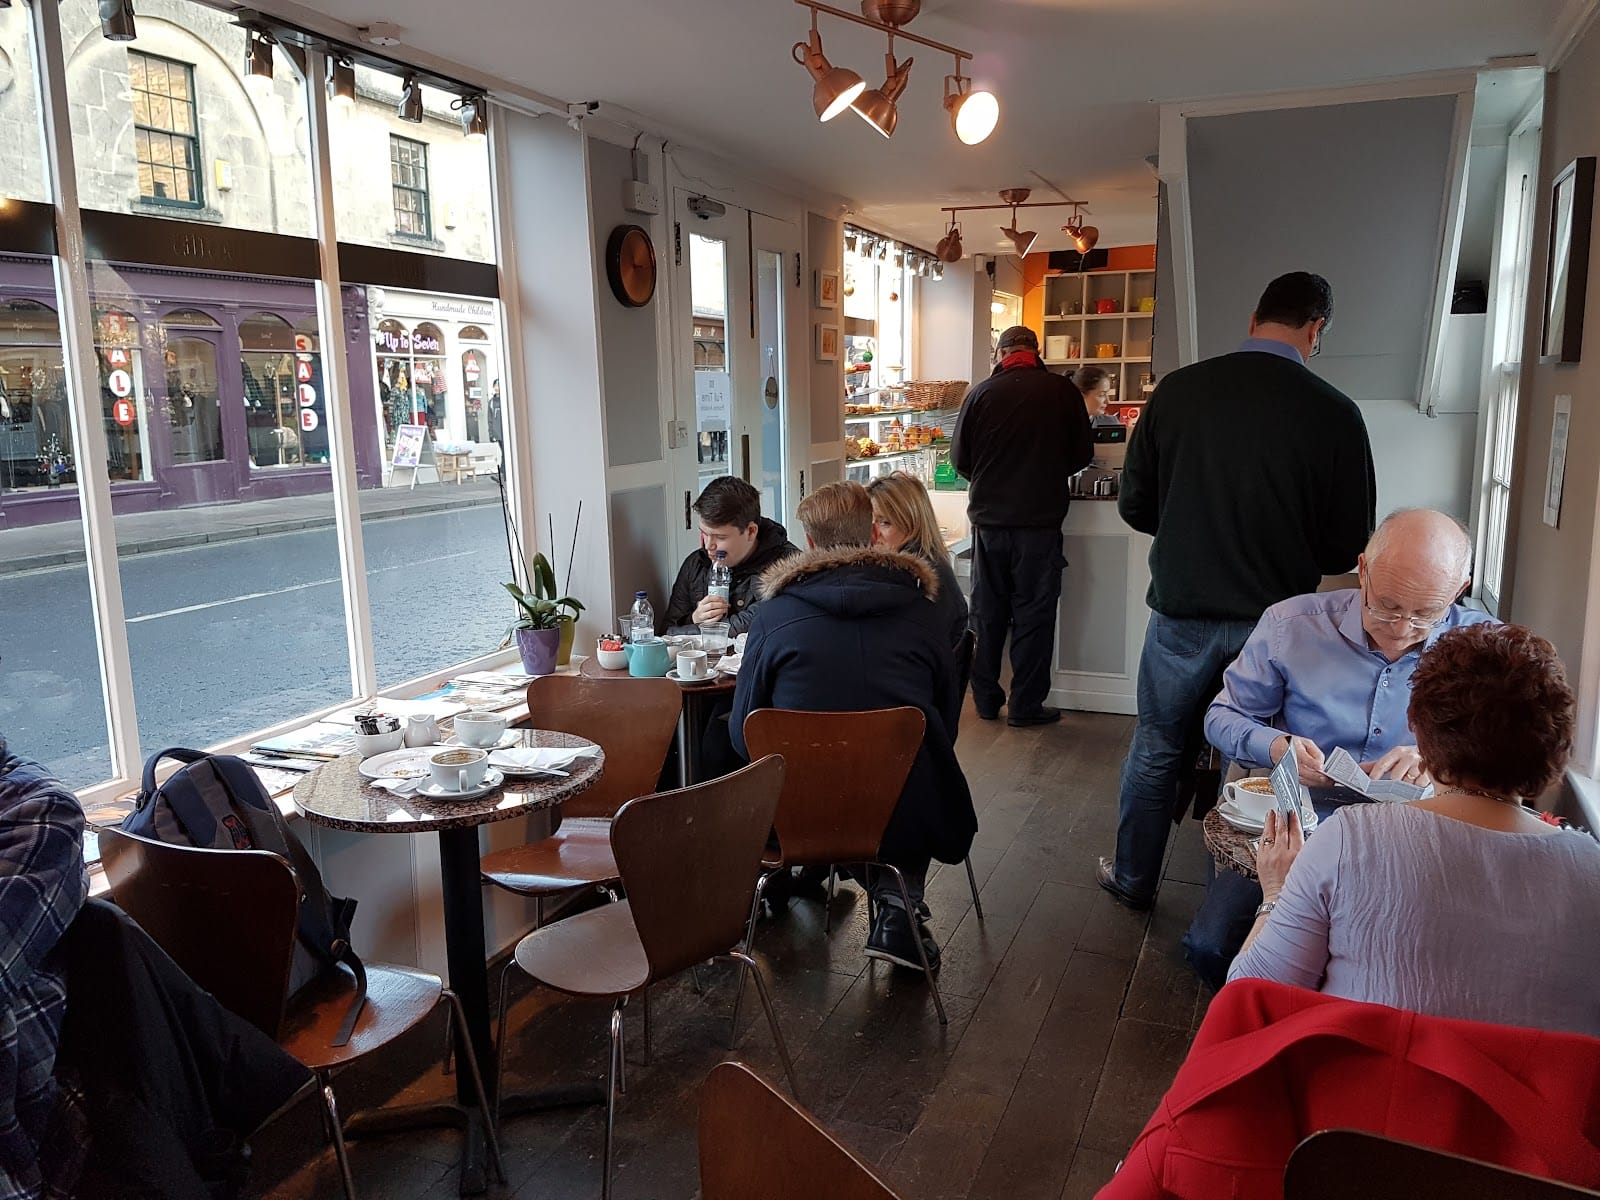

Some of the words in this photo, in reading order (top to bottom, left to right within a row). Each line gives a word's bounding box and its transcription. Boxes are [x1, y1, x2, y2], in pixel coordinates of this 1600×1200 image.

[432, 301, 466, 314] Handmade
[108, 314, 130, 422] SALE
[384, 332, 399, 352] Up
[400, 333, 409, 349] to
[412, 334, 440, 352] Seven
[295, 337, 313, 428] SALE
